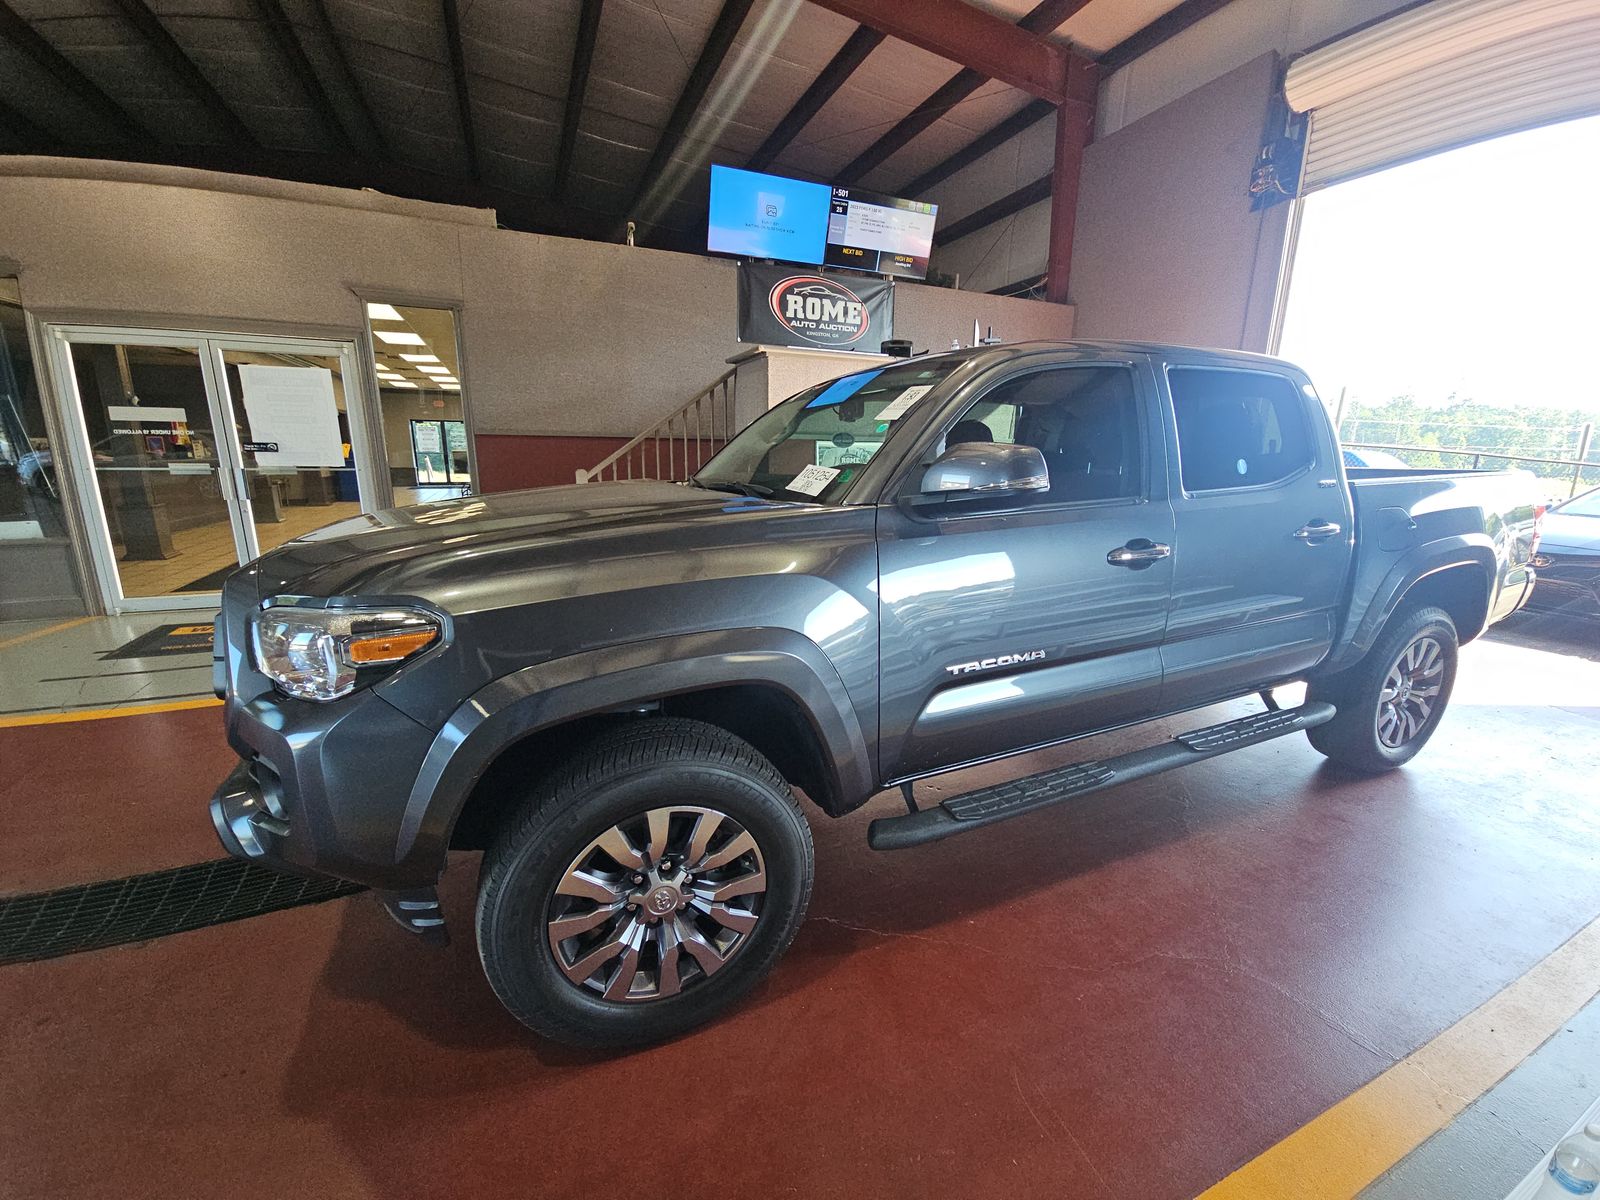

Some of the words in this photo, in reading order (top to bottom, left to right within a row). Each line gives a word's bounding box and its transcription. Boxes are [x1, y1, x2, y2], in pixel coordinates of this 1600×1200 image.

[832, 188, 849, 198] I-501
[786, 294, 862, 324] ROME
[790, 320, 816, 328] AUTO
[819, 324, 858, 332] AUCTION
[945, 650, 1046, 674] TACOMA
